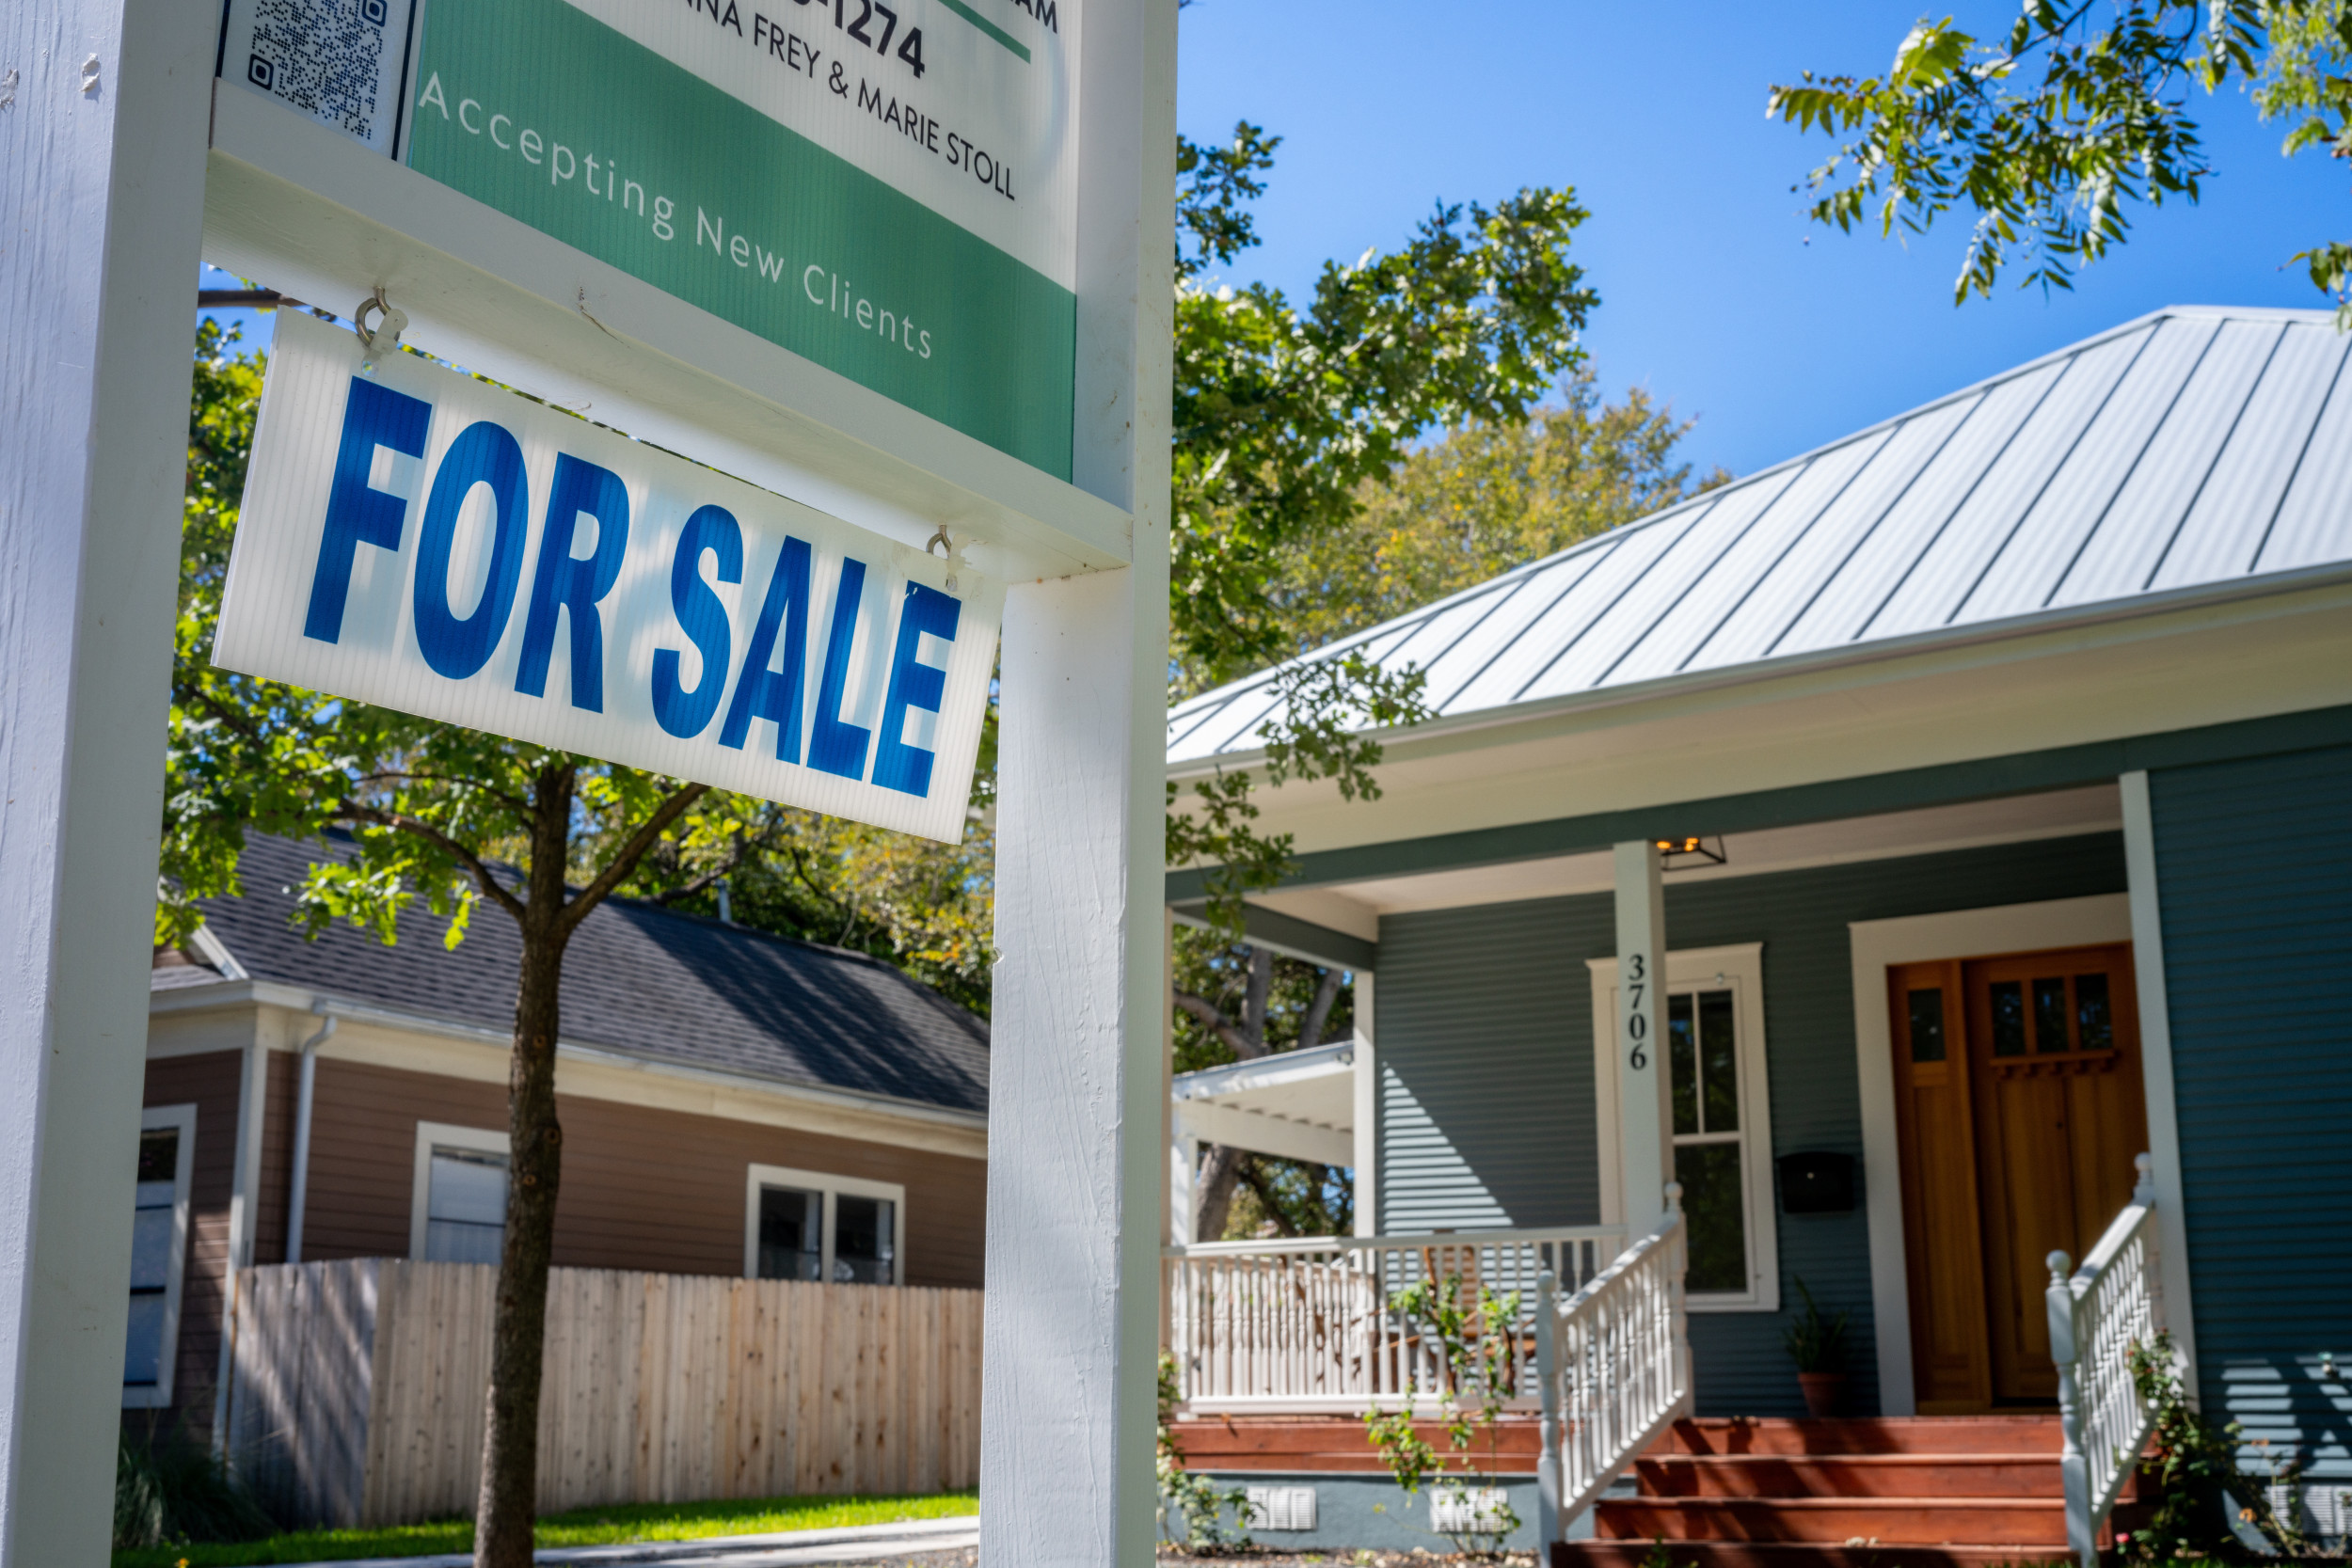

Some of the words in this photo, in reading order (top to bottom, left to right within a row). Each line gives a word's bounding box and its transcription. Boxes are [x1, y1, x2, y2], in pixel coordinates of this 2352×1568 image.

[418, 71, 675, 241] Accepting
[696, 205, 786, 284] New
[803, 263, 932, 360] Clients
[754, 12, 822, 79] FREY
[828, 60, 850, 99] &
[857, 77, 940, 154] MARIE
[946, 132, 1015, 201] STOLL
[303, 375, 630, 714] FOR
[651, 504, 961, 799] SALE
[1628, 953, 1647, 1071] 3706
